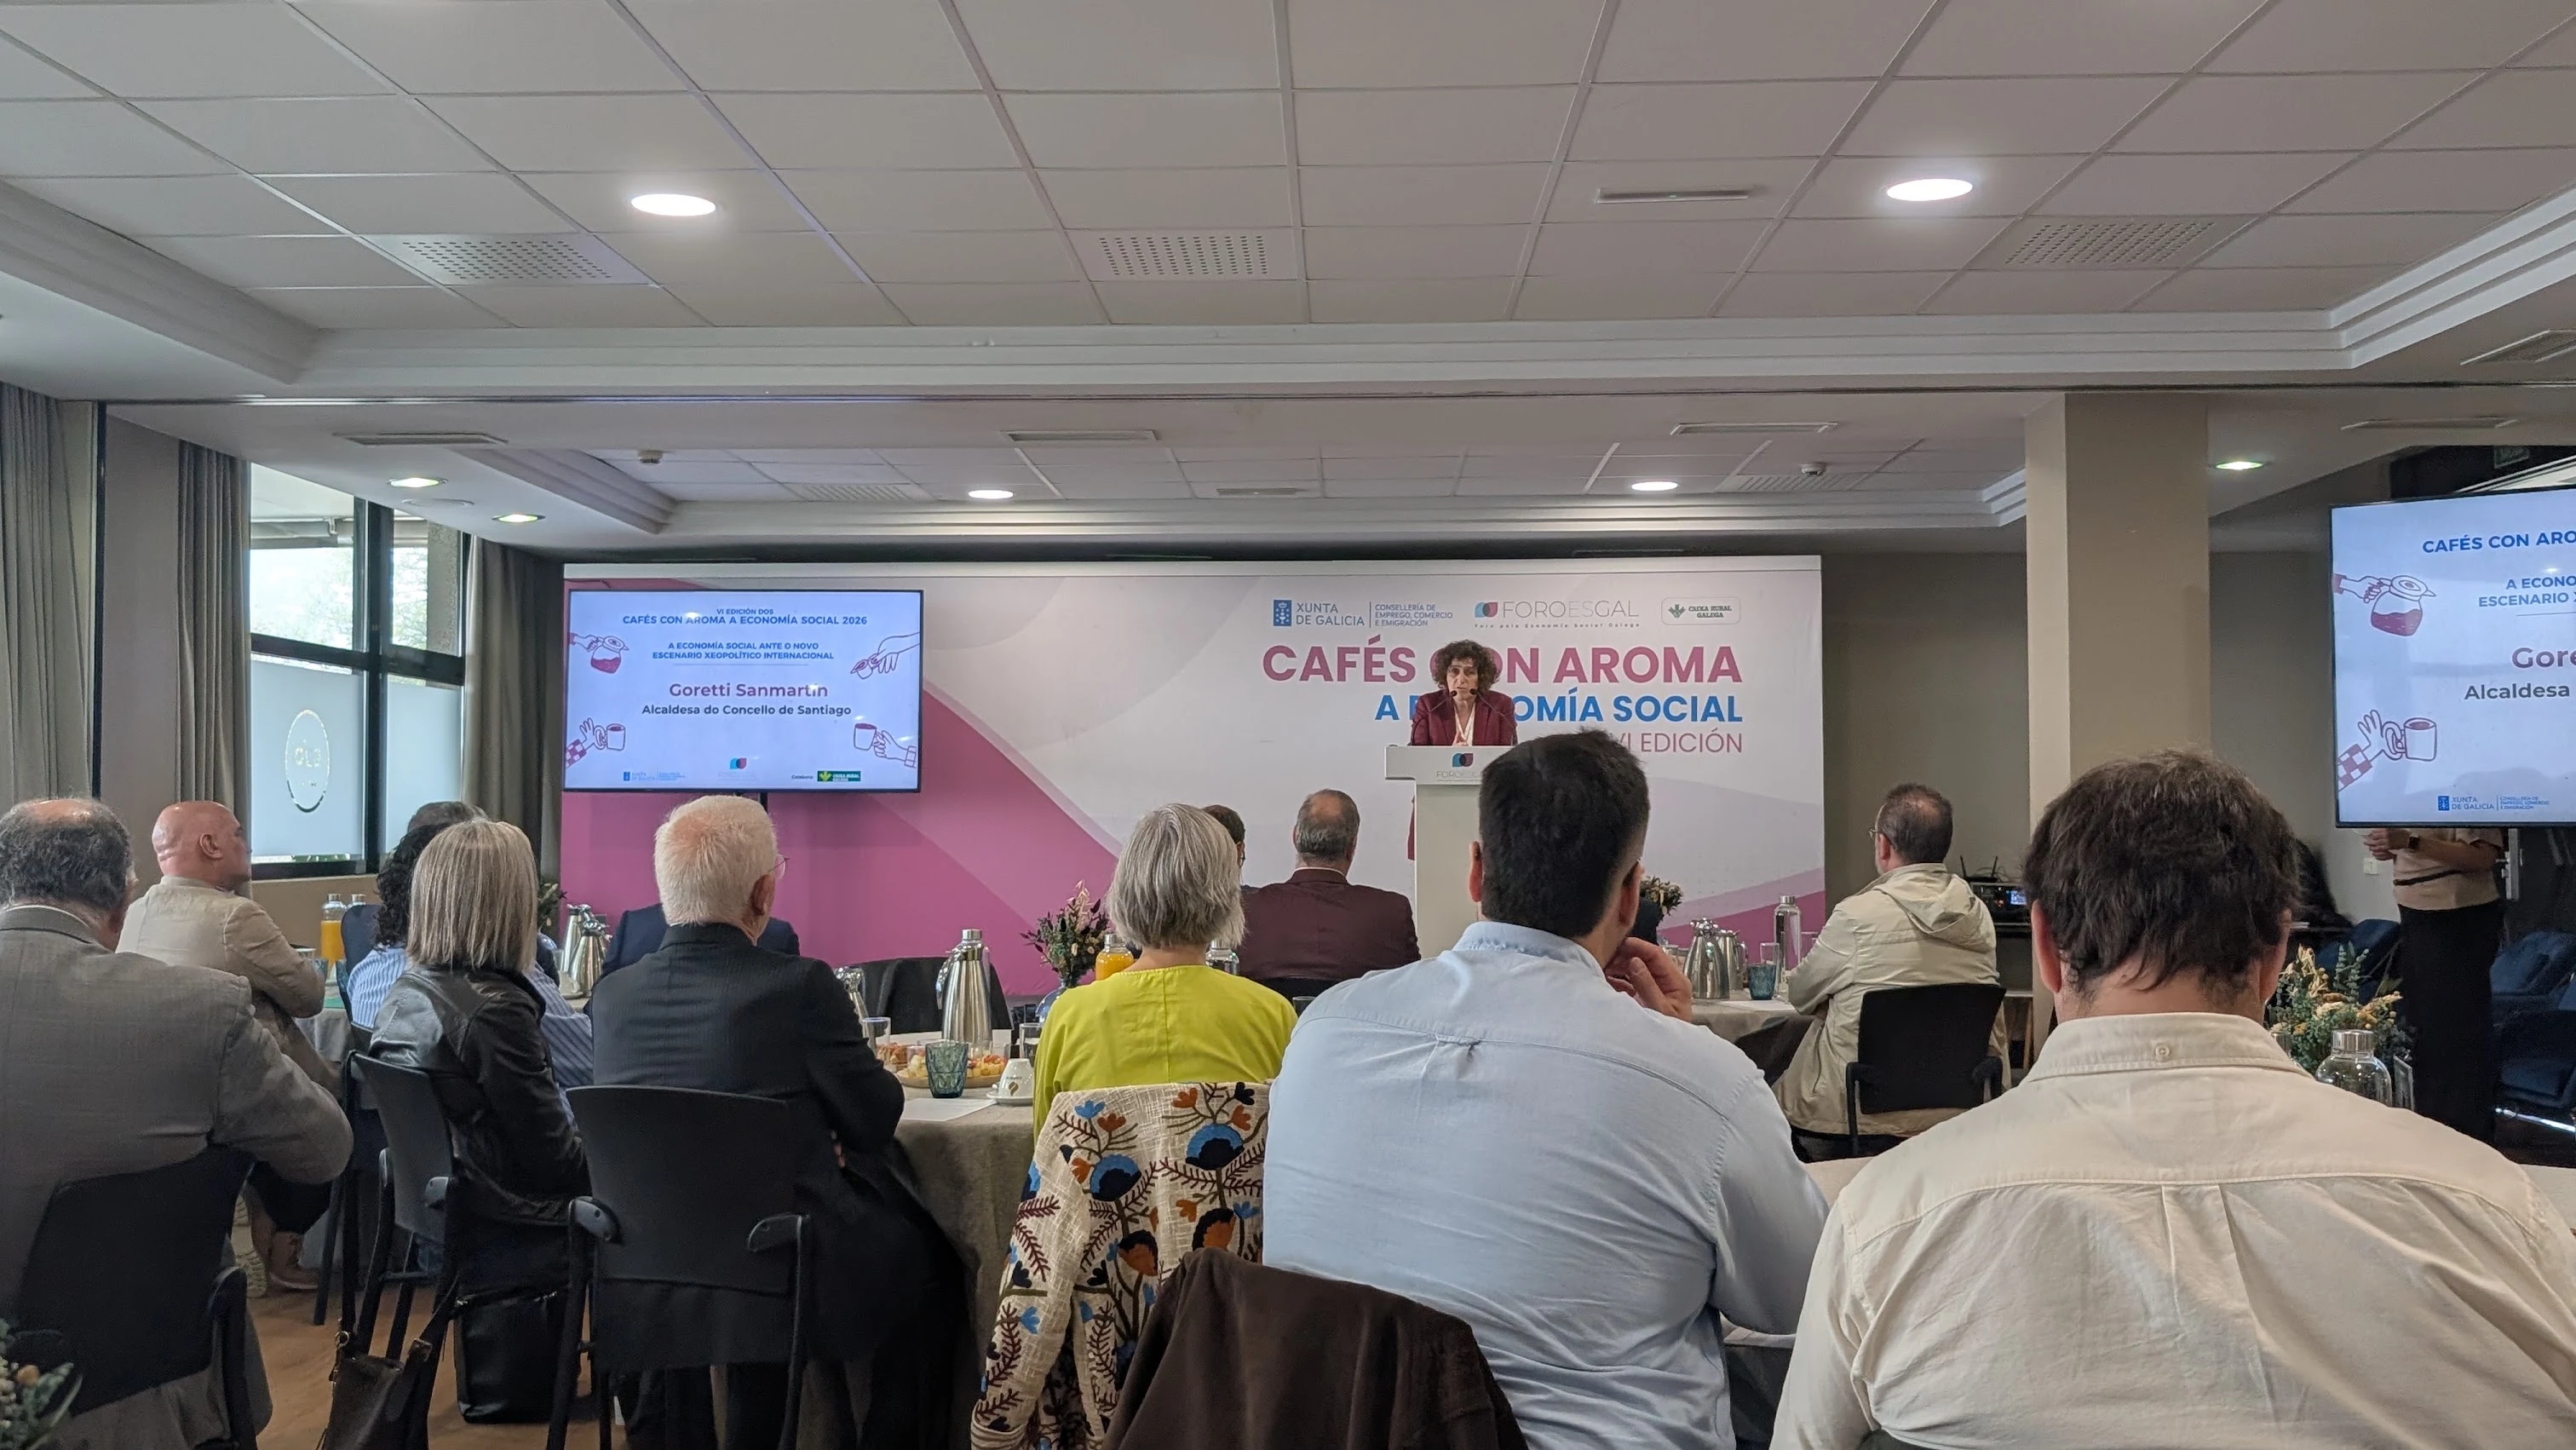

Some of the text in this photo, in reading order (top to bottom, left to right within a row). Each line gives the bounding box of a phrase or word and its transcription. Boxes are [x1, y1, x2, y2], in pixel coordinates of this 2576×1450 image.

[2423, 534, 2482, 553] CAFÉS
[2488, 533, 2529, 549] CON
[2505, 578, 2517, 590] A
[2478, 592, 2569, 607] ESCENARIO
[1297, 602, 1338, 613] XUNTA
[1375, 602, 1423, 612] CONSELLERÍA
[623, 613, 868, 624] CAFÉS CON AROMA A ECONOMÍA SOCIAL 2026
[1296, 614, 1365, 626] DE GALICIA
[1381, 618, 1428, 626] EMIGRACIÓN
[676, 641, 724, 649] ECONOMÍA
[704, 650, 762, 659] XEOPOLÍTICO
[763, 652, 835, 660] INTERNACIONAL
[1262, 634, 1417, 683] CAFÉS
[1552, 646, 1743, 683] AROMA
[669, 683, 731, 697] Goretti
[2464, 682, 2570, 700] Alcaldesa
[641, 704, 852, 717] Alcaldesa do Concello de Santiago
[1375, 694, 1400, 721] A
[1613, 695, 1743, 722] SOCIAL
[1641, 728, 1743, 753] EDICIÓN
